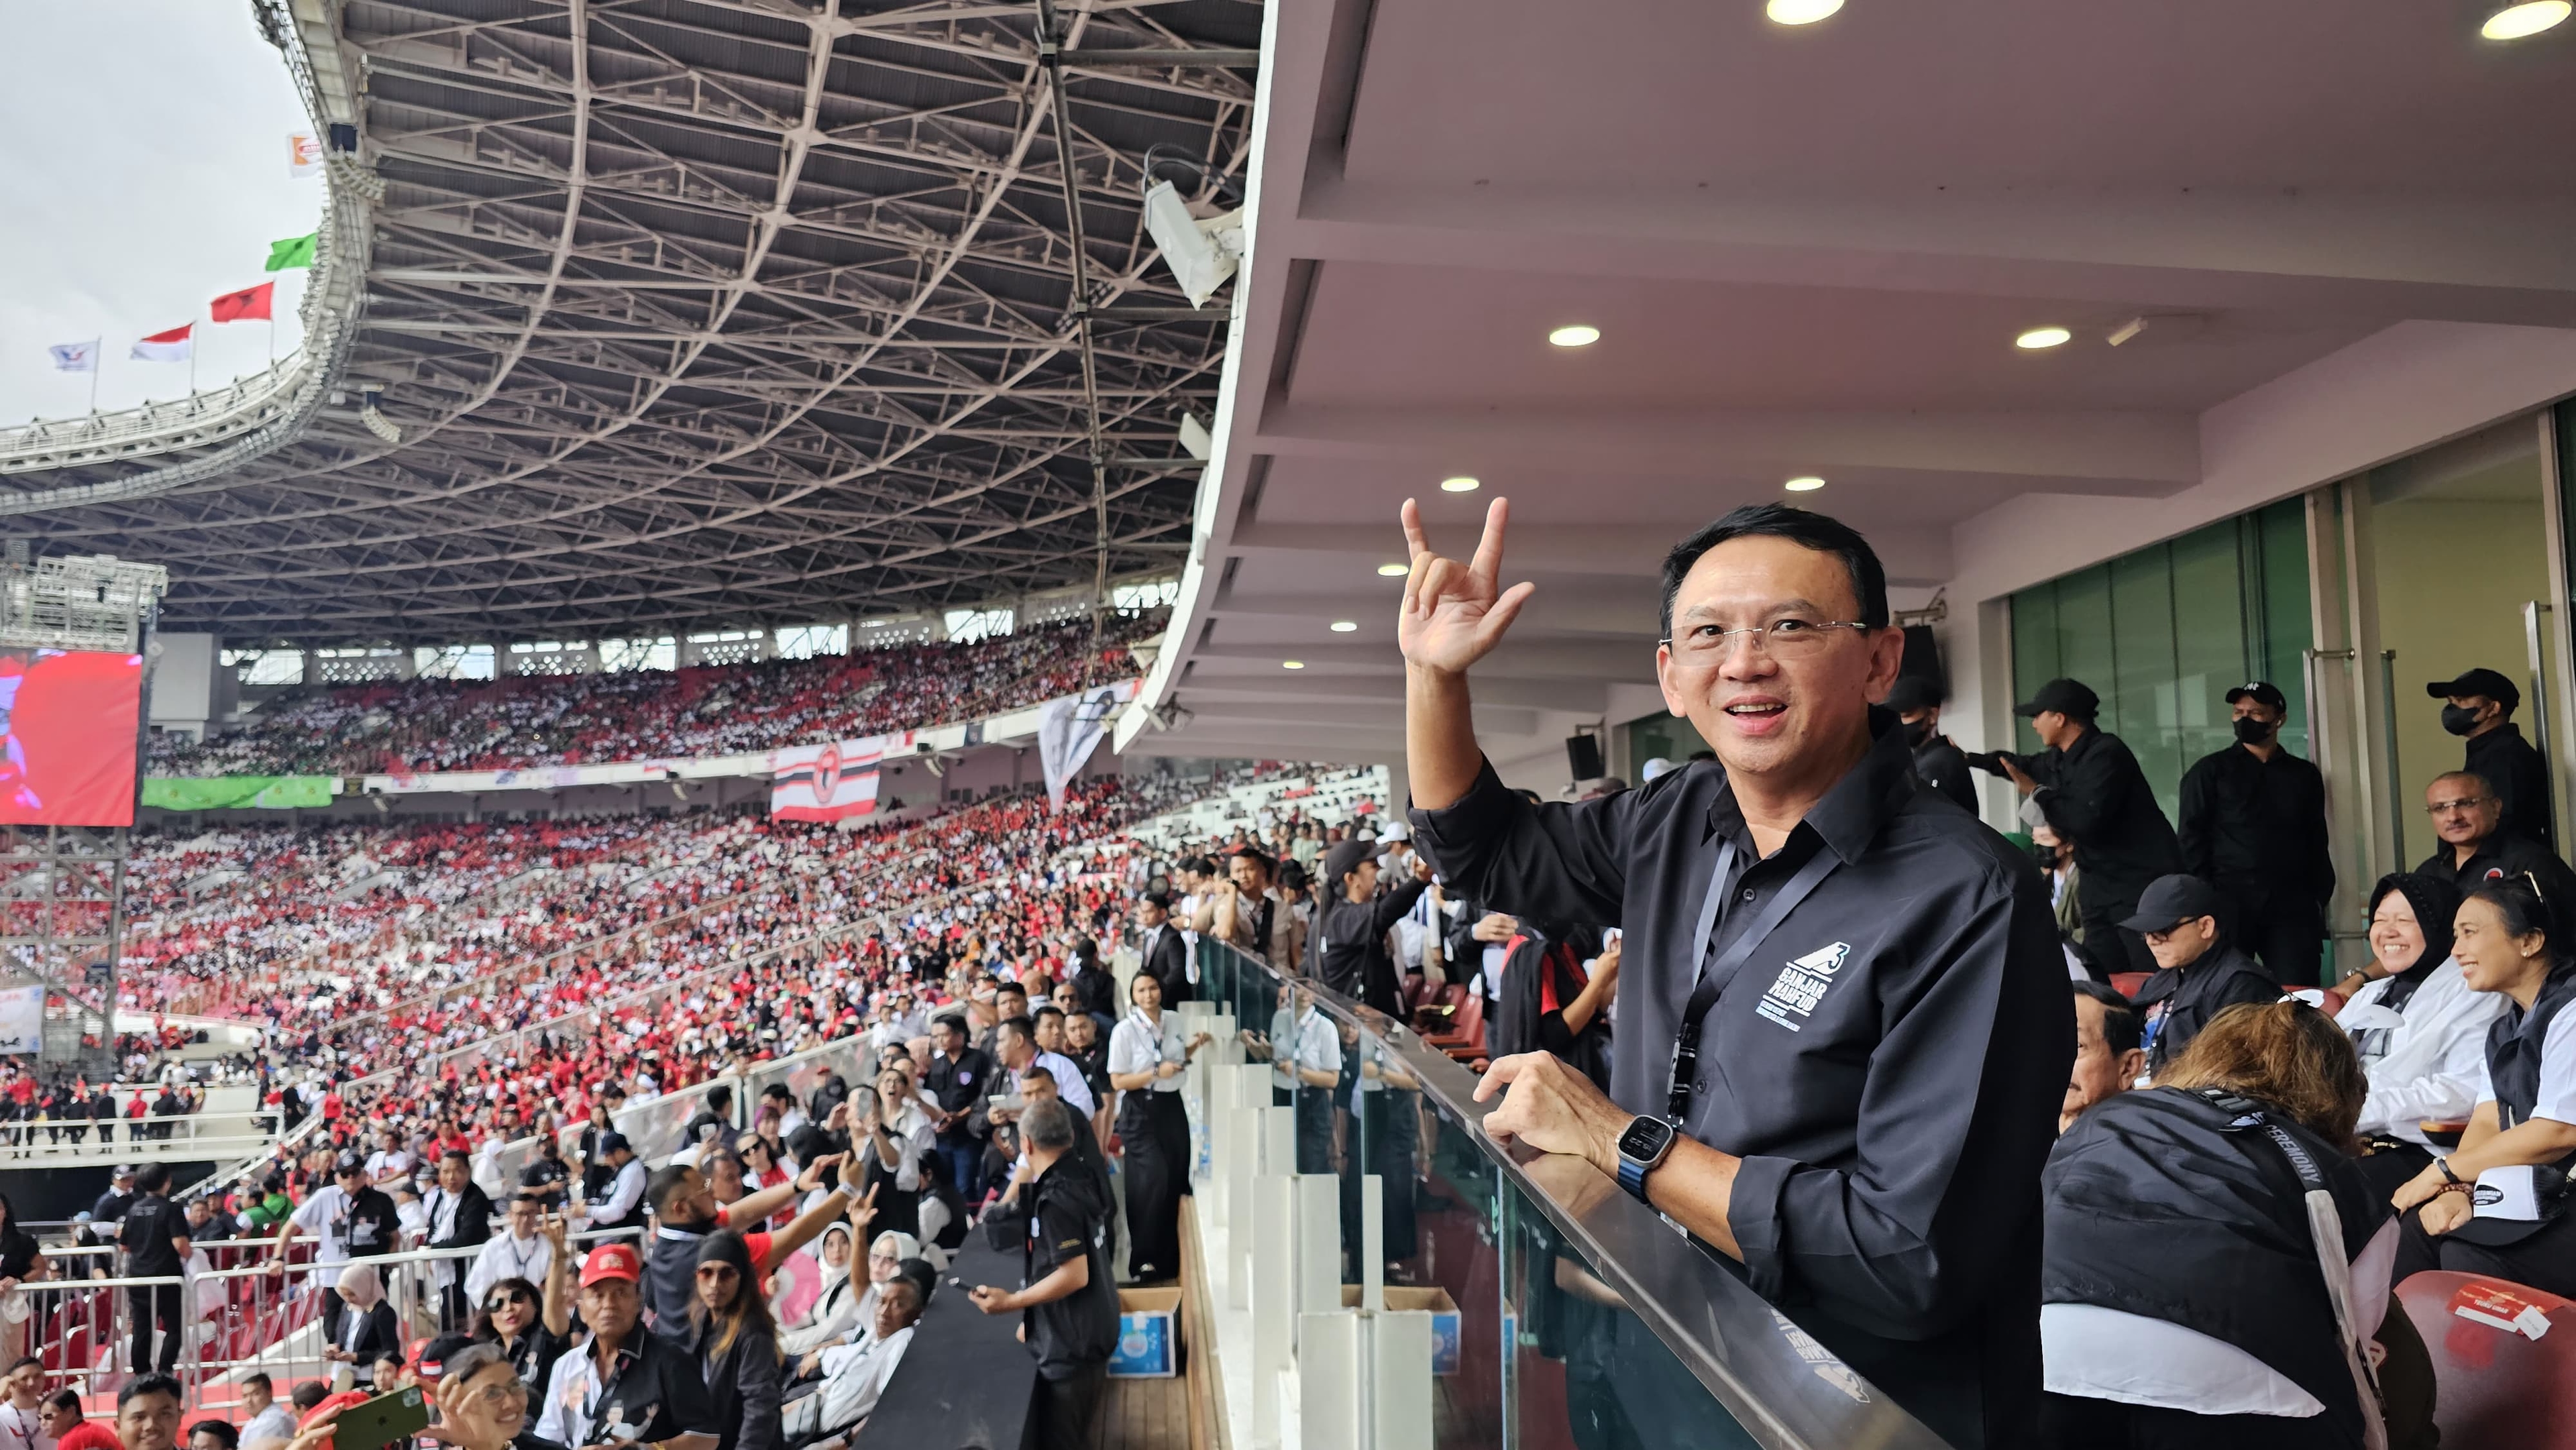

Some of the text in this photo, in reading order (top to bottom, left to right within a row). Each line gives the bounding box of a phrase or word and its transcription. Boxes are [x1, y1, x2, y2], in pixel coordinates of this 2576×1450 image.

[1768, 980, 1819, 1012] MAHFUD
[1778, 967, 1828, 1000] GANJAR
[2263, 1124, 2321, 1183] CEREMONY
